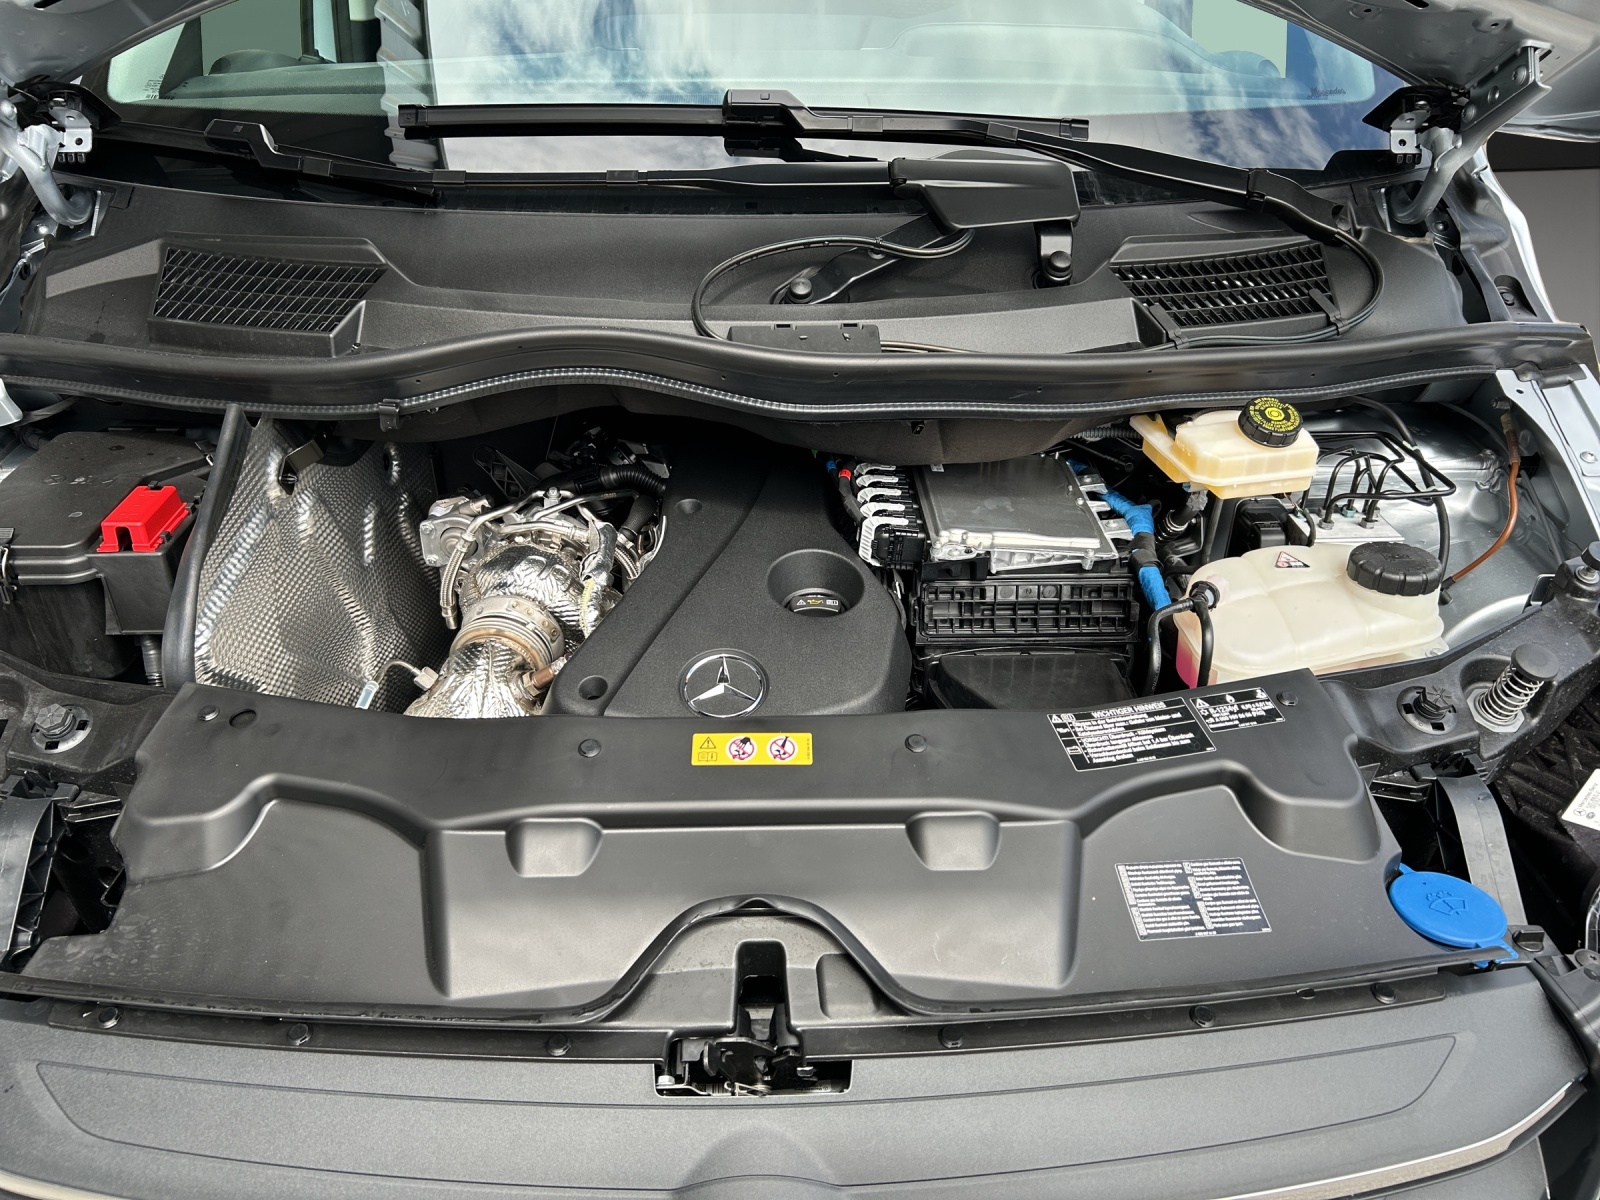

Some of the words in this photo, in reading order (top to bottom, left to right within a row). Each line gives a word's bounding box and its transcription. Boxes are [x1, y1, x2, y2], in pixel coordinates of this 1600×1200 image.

[1306, 87, 1346, 99] Mercedes
[1091, 706, 1134, 719] WICHTIGER
[1134, 702, 1166, 713] HINWEIS
[1209, 705, 1239, 714] R-1234yf
